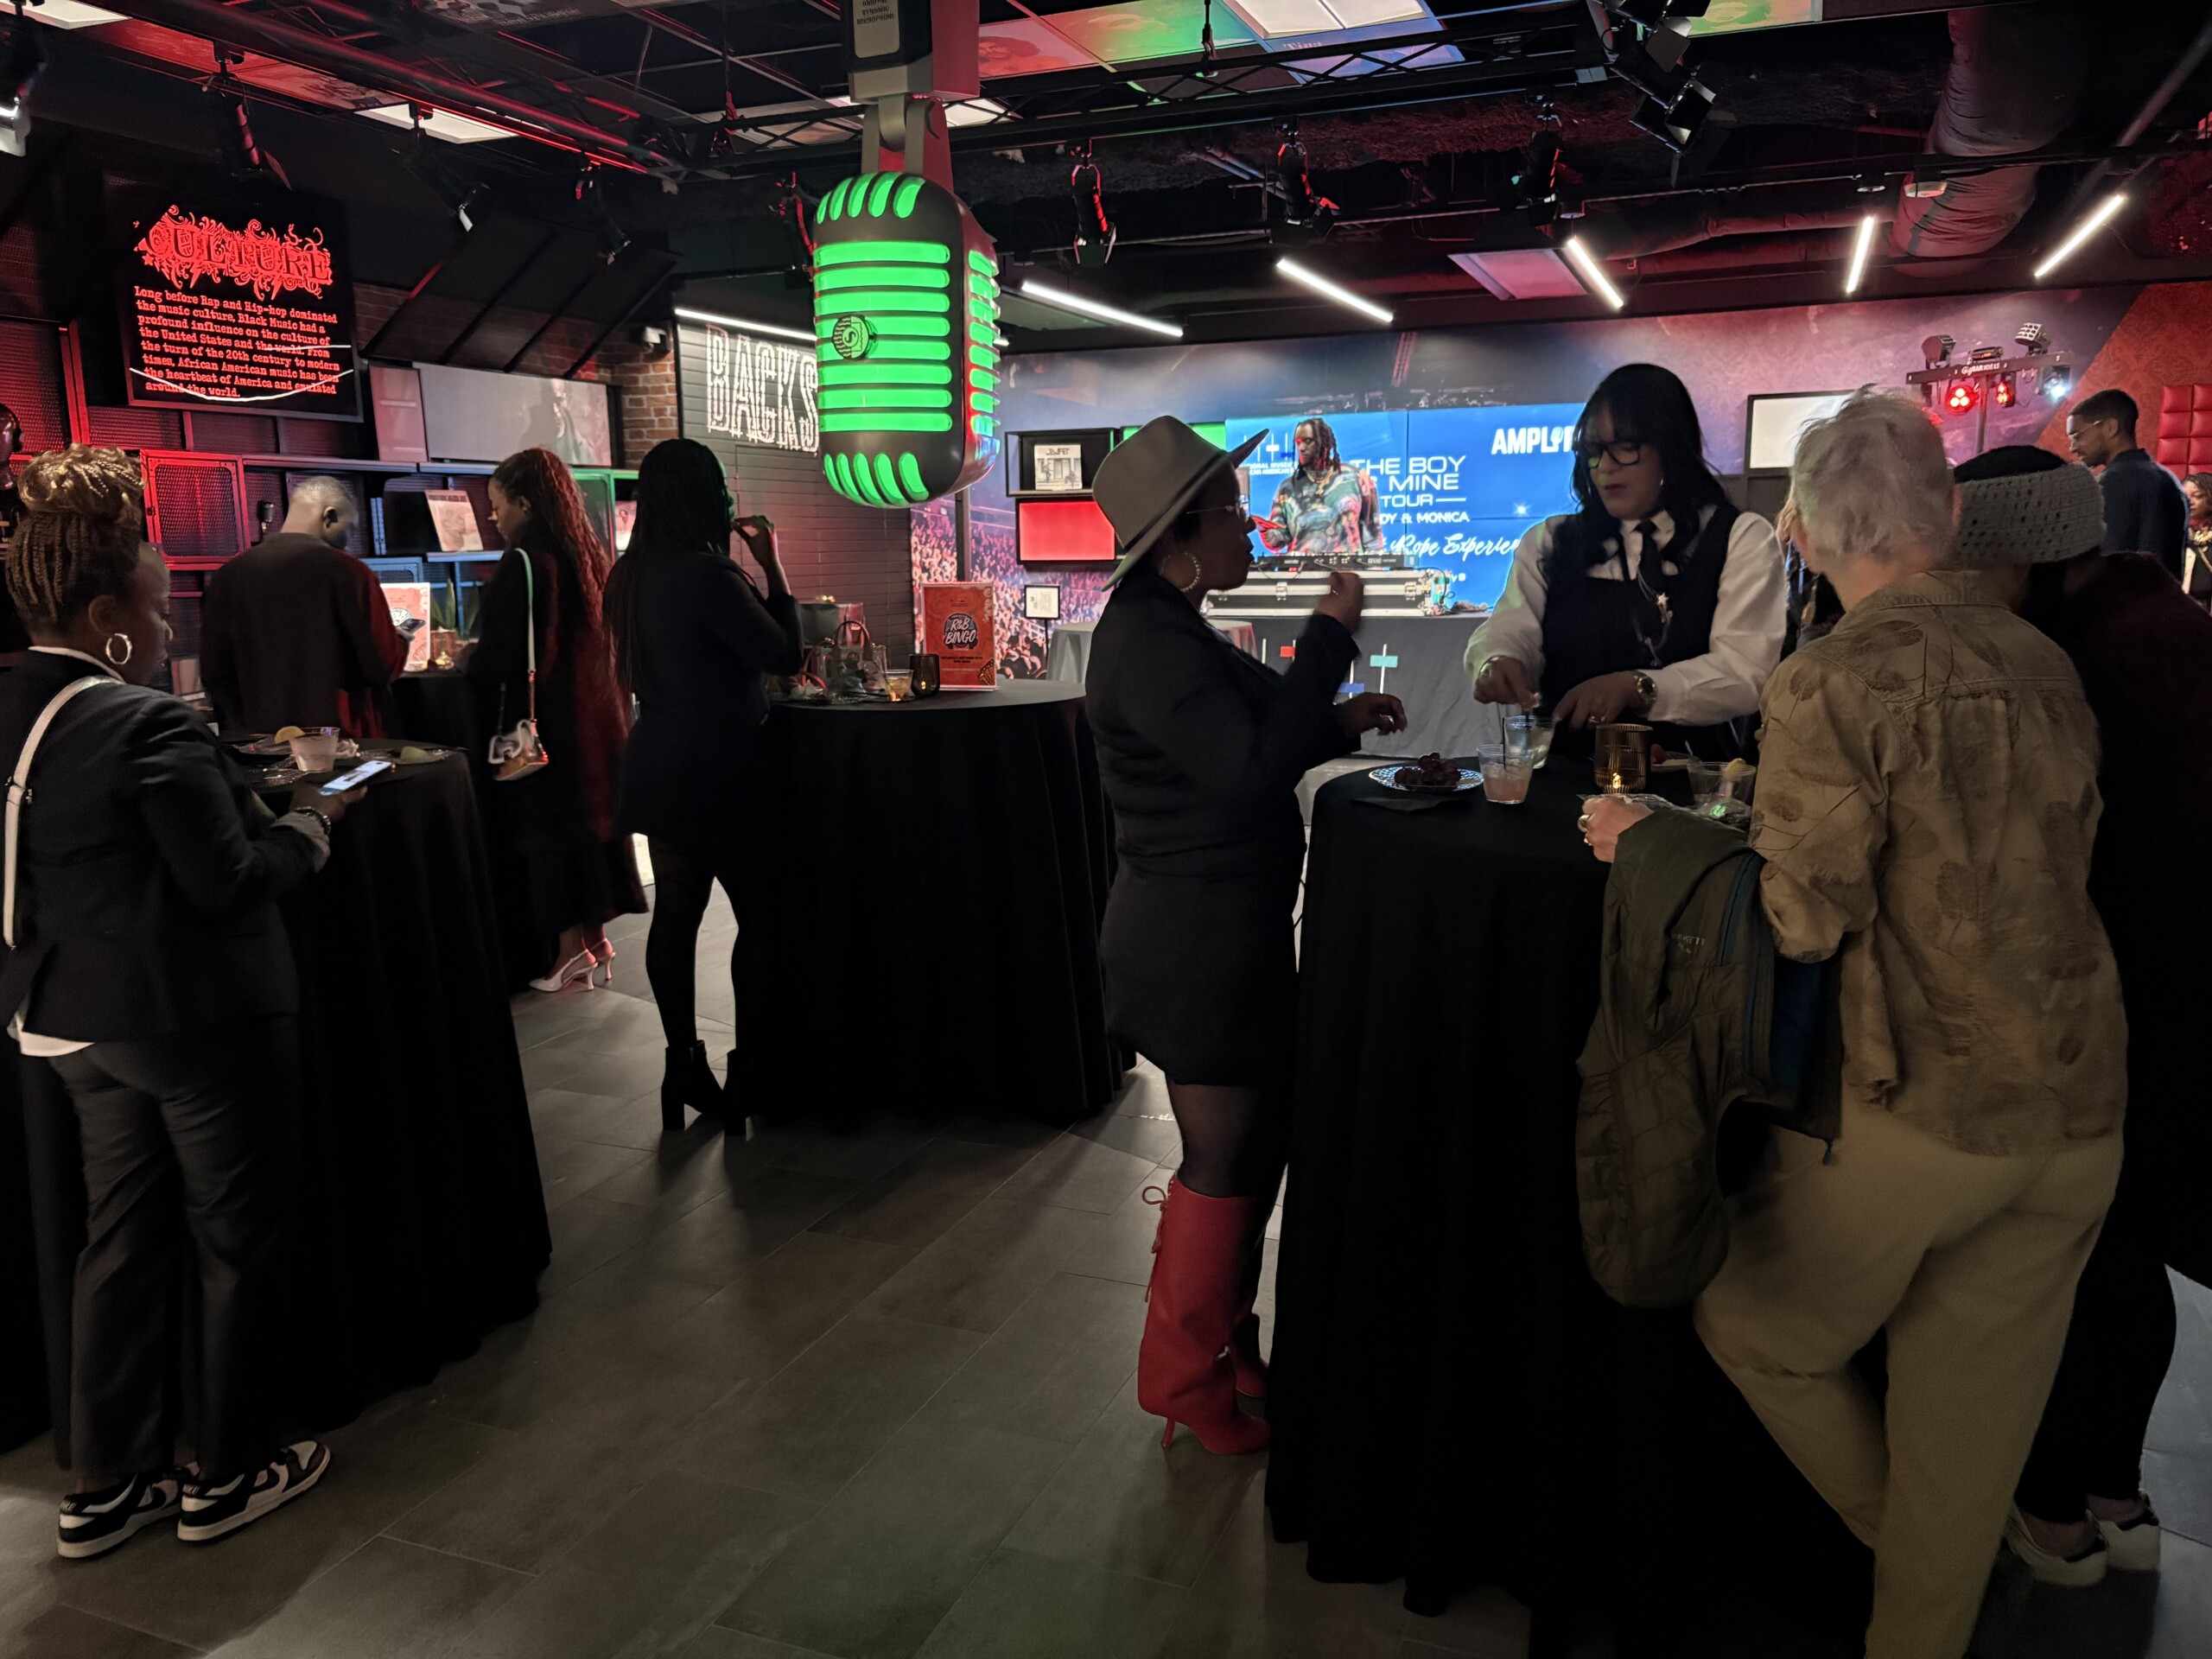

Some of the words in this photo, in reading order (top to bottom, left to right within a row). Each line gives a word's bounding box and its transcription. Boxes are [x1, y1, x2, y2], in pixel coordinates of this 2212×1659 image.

[133, 209, 334, 297] CULTURE
[134, 286, 162, 303] Long
[164, 290, 199, 304] before
[200, 296, 220, 309] Rap
[222, 300, 242, 310] and
[245, 301, 287, 319] Hip-hop
[289, 308, 338, 324] dominated
[136, 300, 156, 311] the
[158, 304, 190, 315] music
[193, 308, 235, 327] culture,
[238, 313, 268, 327] Black
[270, 317, 298, 330] Music
[299, 321, 317, 333] had
[137, 315, 188, 329] profound
[191, 320, 244, 335] influence
[245, 328, 259, 338] on
[261, 329, 278, 340] the
[281, 333, 318, 345] culture
[319, 337, 330, 346] of
[139, 327, 159, 338] the
[161, 329, 198, 343] United
[200, 334, 232, 346] States
[234, 340, 253, 349] and
[255, 340, 275, 351] the
[308, 347, 330, 359] From
[141, 340, 161, 351] the
[162, 342, 189, 354] turn
[191, 346, 203, 356] of
[206, 347, 224, 358] the
[226, 349, 250, 361] 20th
[252, 354, 291, 368] century
[294, 357, 305, 367] to
[307, 360, 340, 371] modern
[143, 353, 175, 366] times,
[178, 357, 219, 371] African
[221, 362, 267, 375] American
[270, 368, 297, 378] music
[299, 370, 316, 380] has
[318, 372, 339, 383] been
[143, 367, 163, 378] the
[166, 369, 218, 384] heartbeat
[219, 375, 232, 385] of
[234, 376, 273, 388] America
[275, 381, 293, 391] and
[187, 384, 207, 395] the
[207, 387, 241, 397] world.
[1349, 457, 1401, 475] THE
[1408, 454, 1466, 474] BOY
[1389, 473, 1459, 492] MINE
[1380, 493, 1433, 508] TOUR
[1401, 512, 1413, 524] &
[1417, 512, 1471, 524] MONICA
[951, 618, 969, 631] R&B
[945, 630, 976, 644] BINGO
